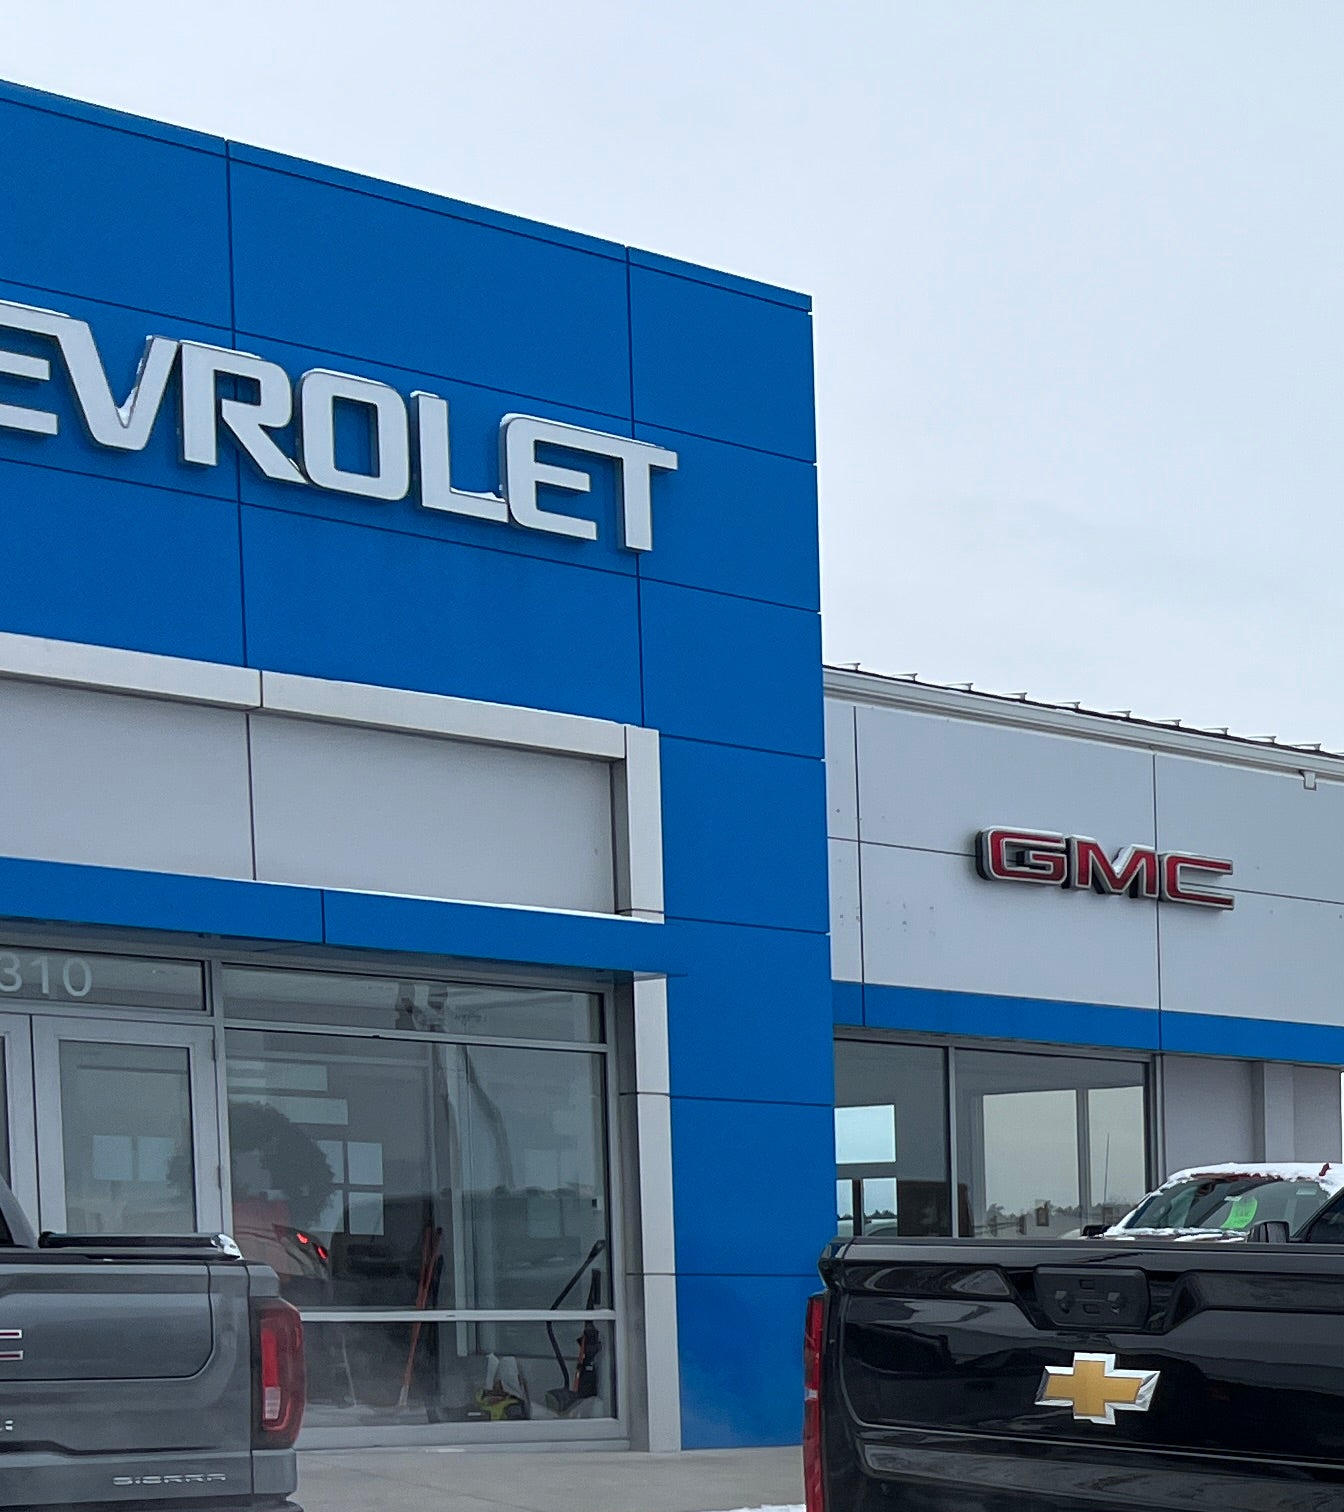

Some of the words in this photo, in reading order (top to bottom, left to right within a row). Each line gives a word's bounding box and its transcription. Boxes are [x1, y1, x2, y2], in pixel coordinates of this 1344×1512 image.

[976, 826, 1234, 910] GMC
[0, 951, 92, 997] 310
[113, 1473, 226, 1486] SIERRA
